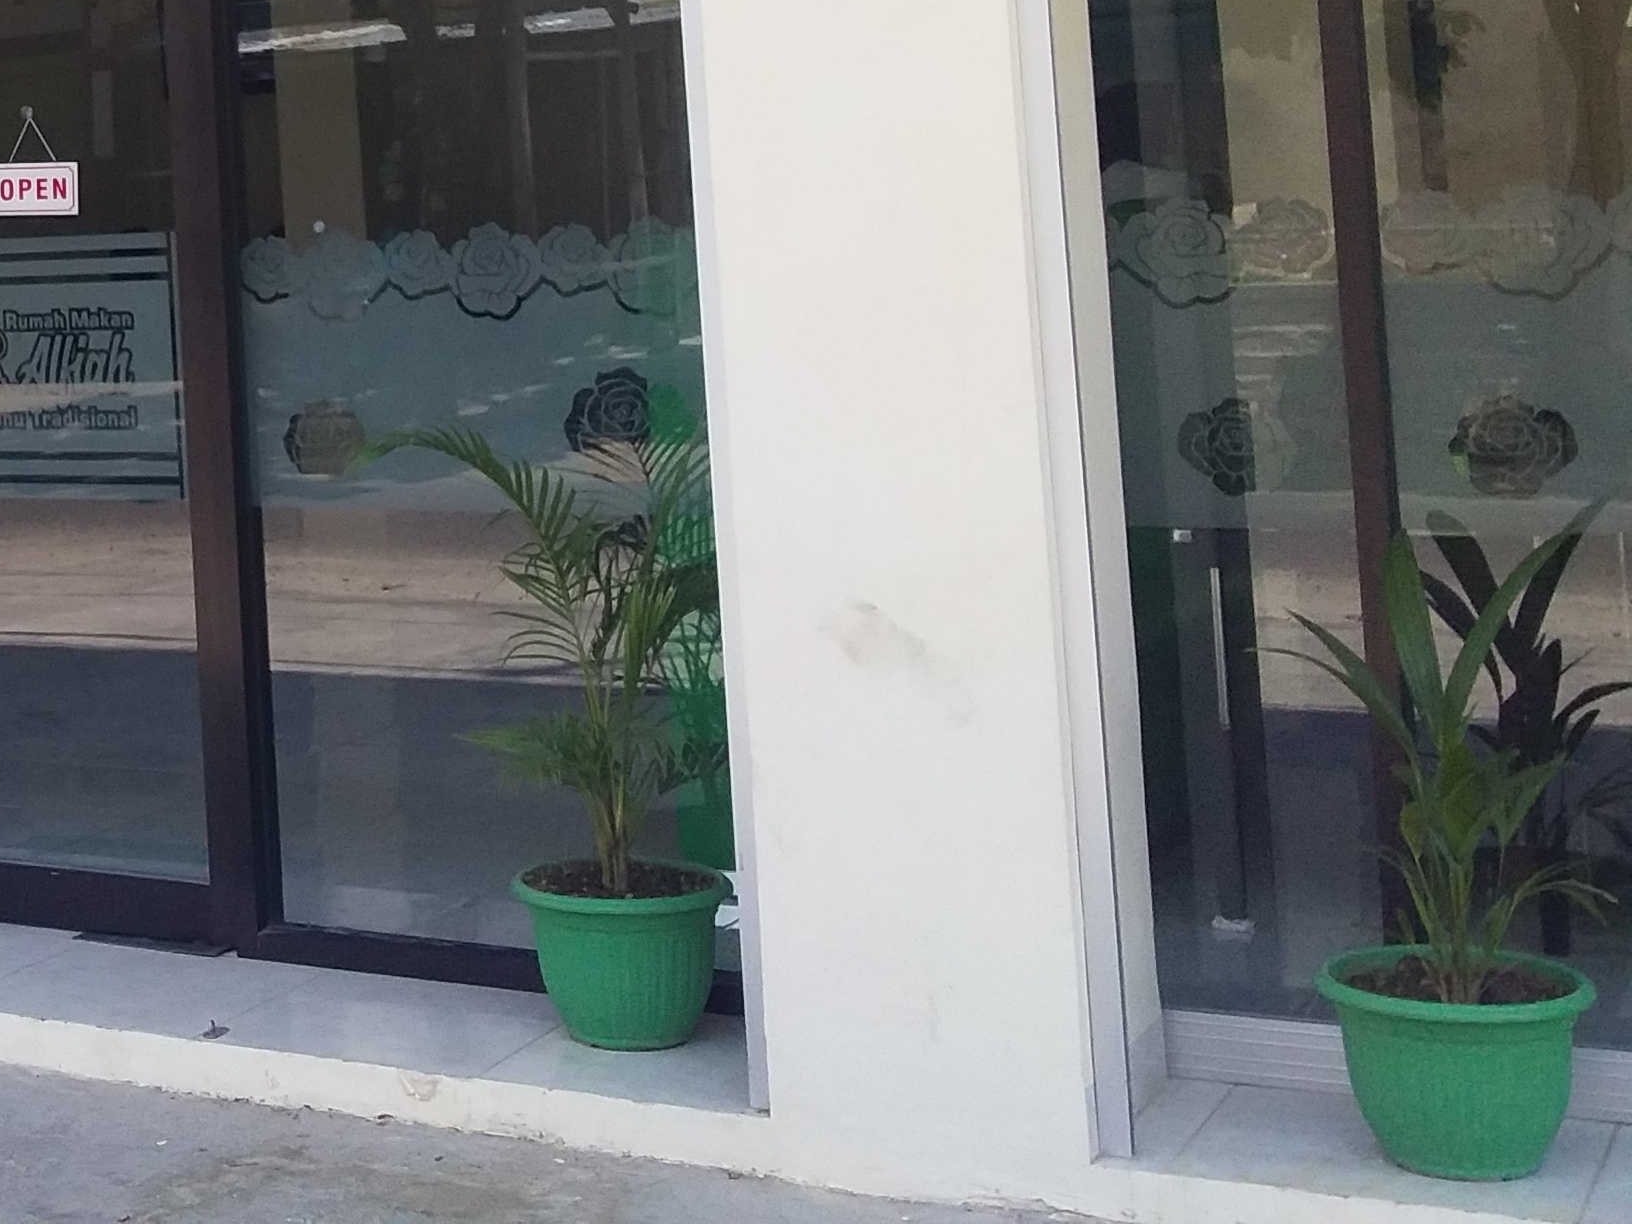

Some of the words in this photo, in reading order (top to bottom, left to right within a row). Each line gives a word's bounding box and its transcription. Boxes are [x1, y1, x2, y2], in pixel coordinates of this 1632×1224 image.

[0, 178, 67, 201] OPEN
[3, 309, 67, 332] Rumah
[69, 307, 134, 330] Makan
